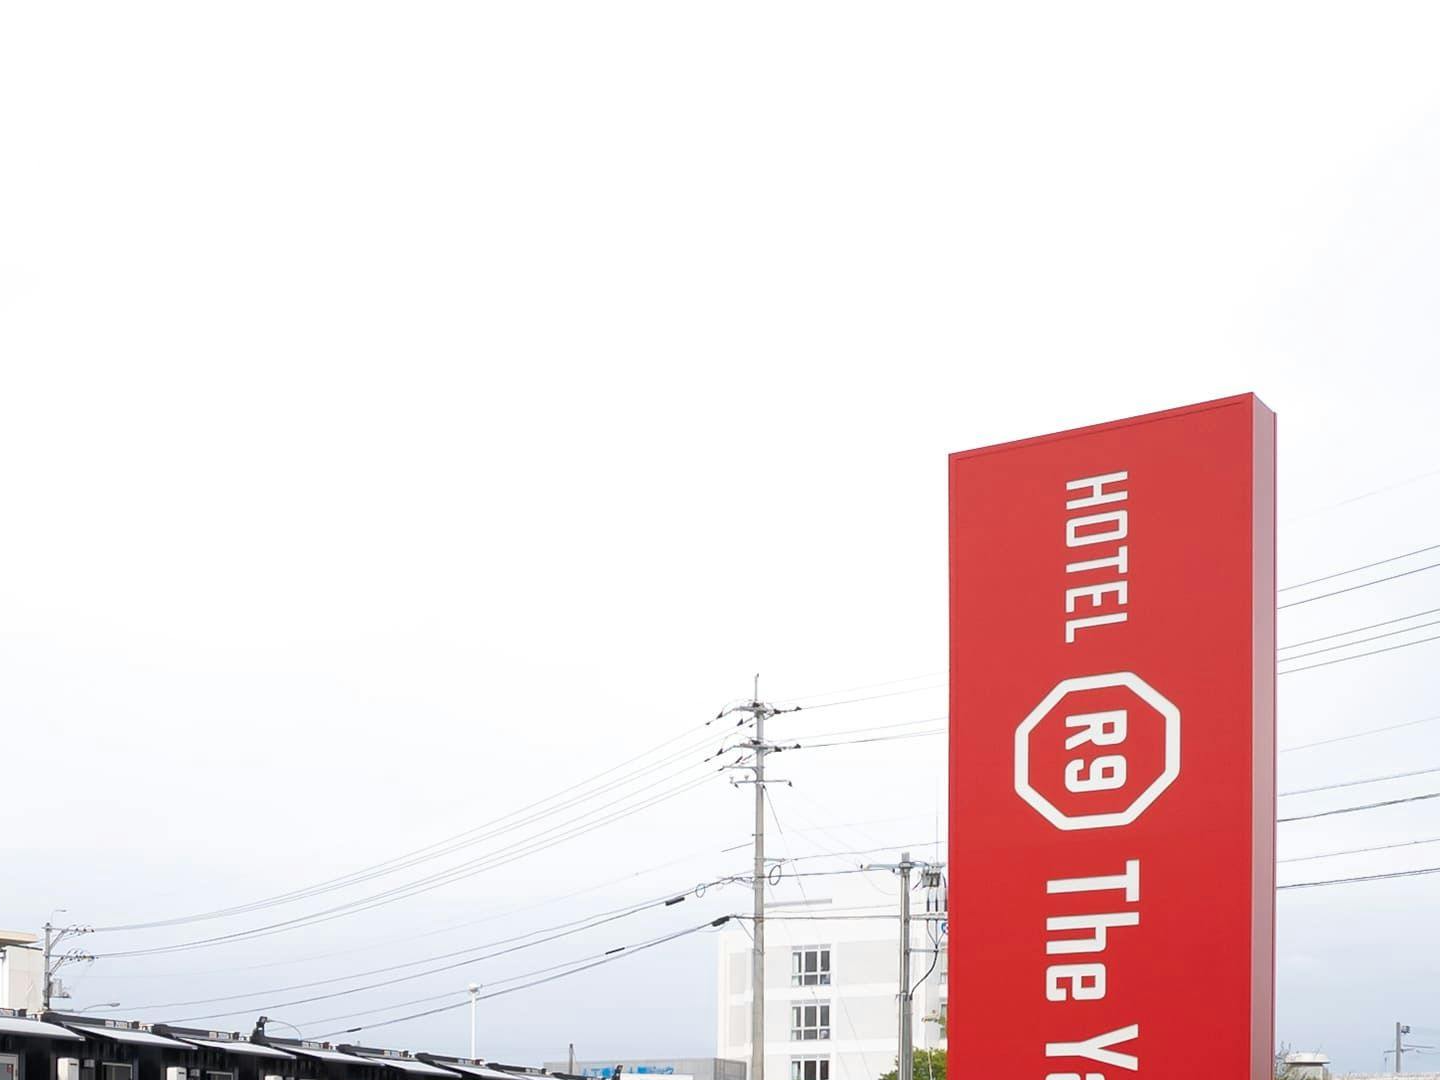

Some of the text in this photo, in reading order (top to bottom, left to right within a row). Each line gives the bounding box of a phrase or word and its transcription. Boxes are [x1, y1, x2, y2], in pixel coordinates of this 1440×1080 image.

[1066, 471, 1128, 643] HOTEL
[1065, 710, 1127, 793] R9
[1046, 860, 1140, 1001] The
